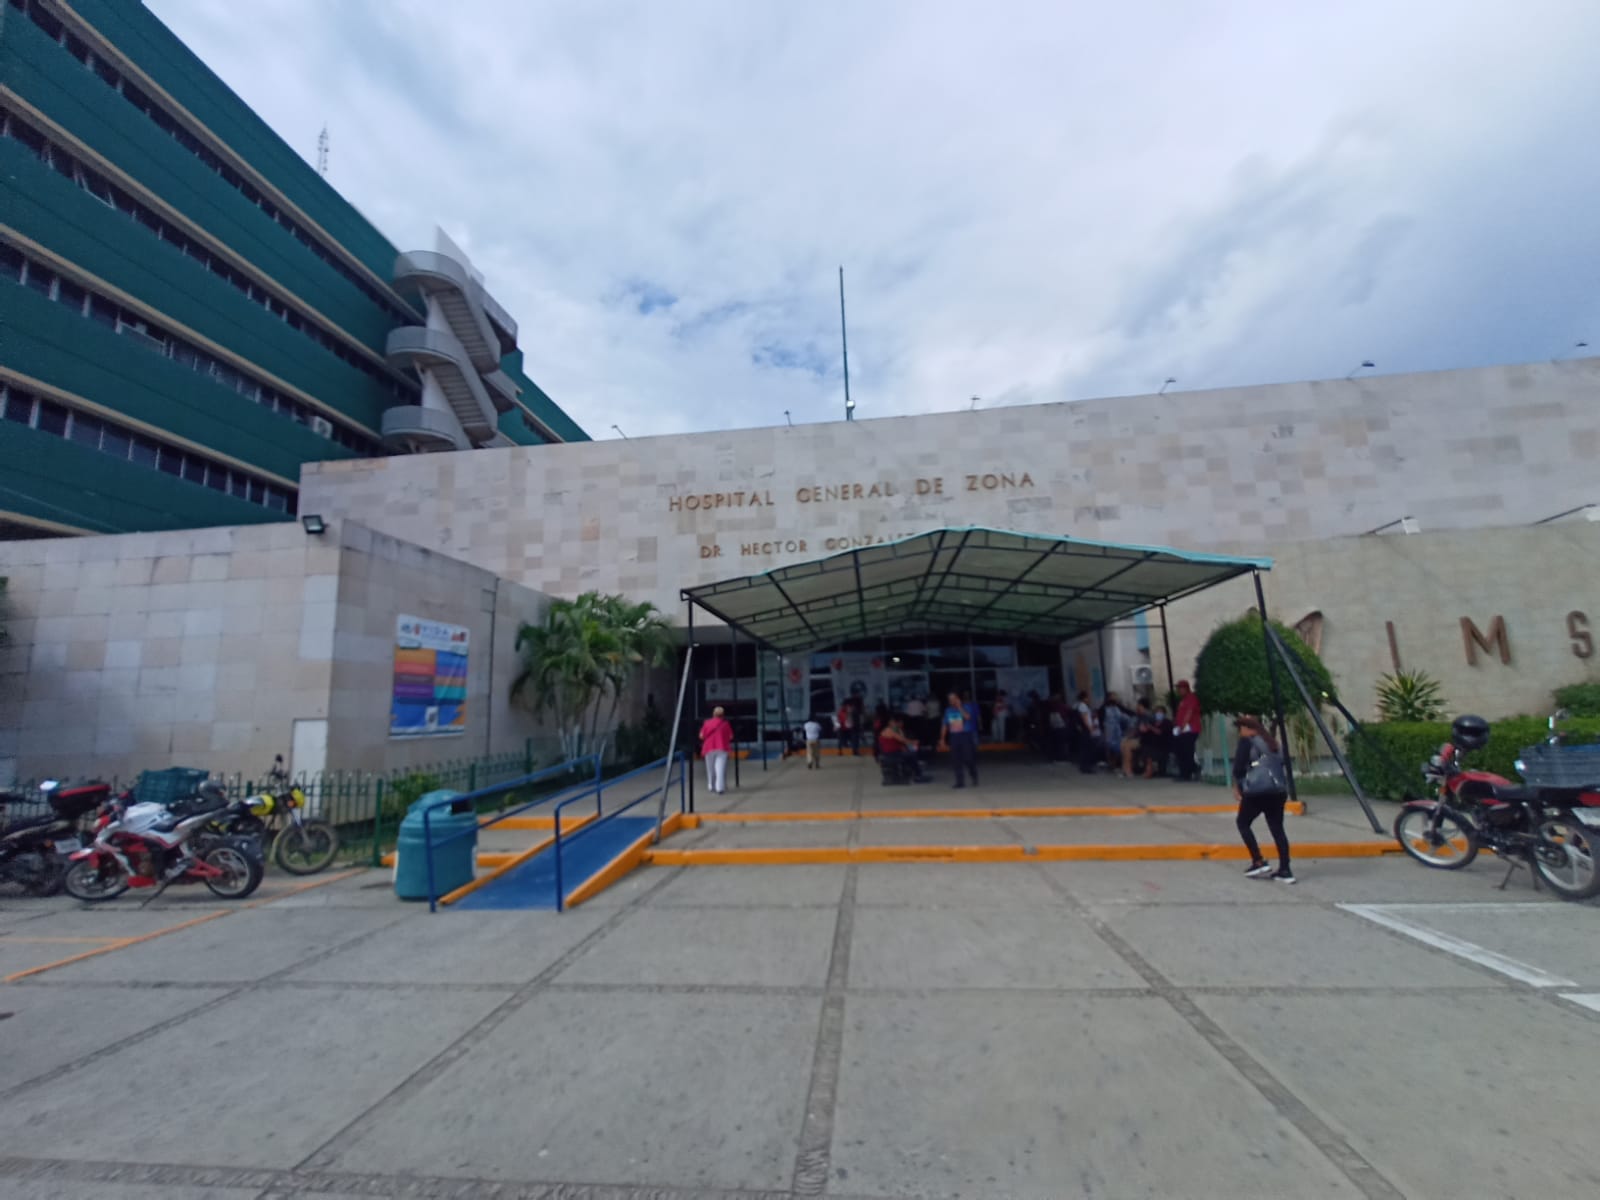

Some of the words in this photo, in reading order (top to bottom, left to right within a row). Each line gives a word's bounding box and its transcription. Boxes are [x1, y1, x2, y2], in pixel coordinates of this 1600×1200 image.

[668, 490, 775, 512] HOSPITAL
[796, 481, 894, 503] GENERAL
[915, 477, 944, 496] DE
[965, 472, 1035, 491] ZONA
[740, 539, 807, 556] HECTOR
